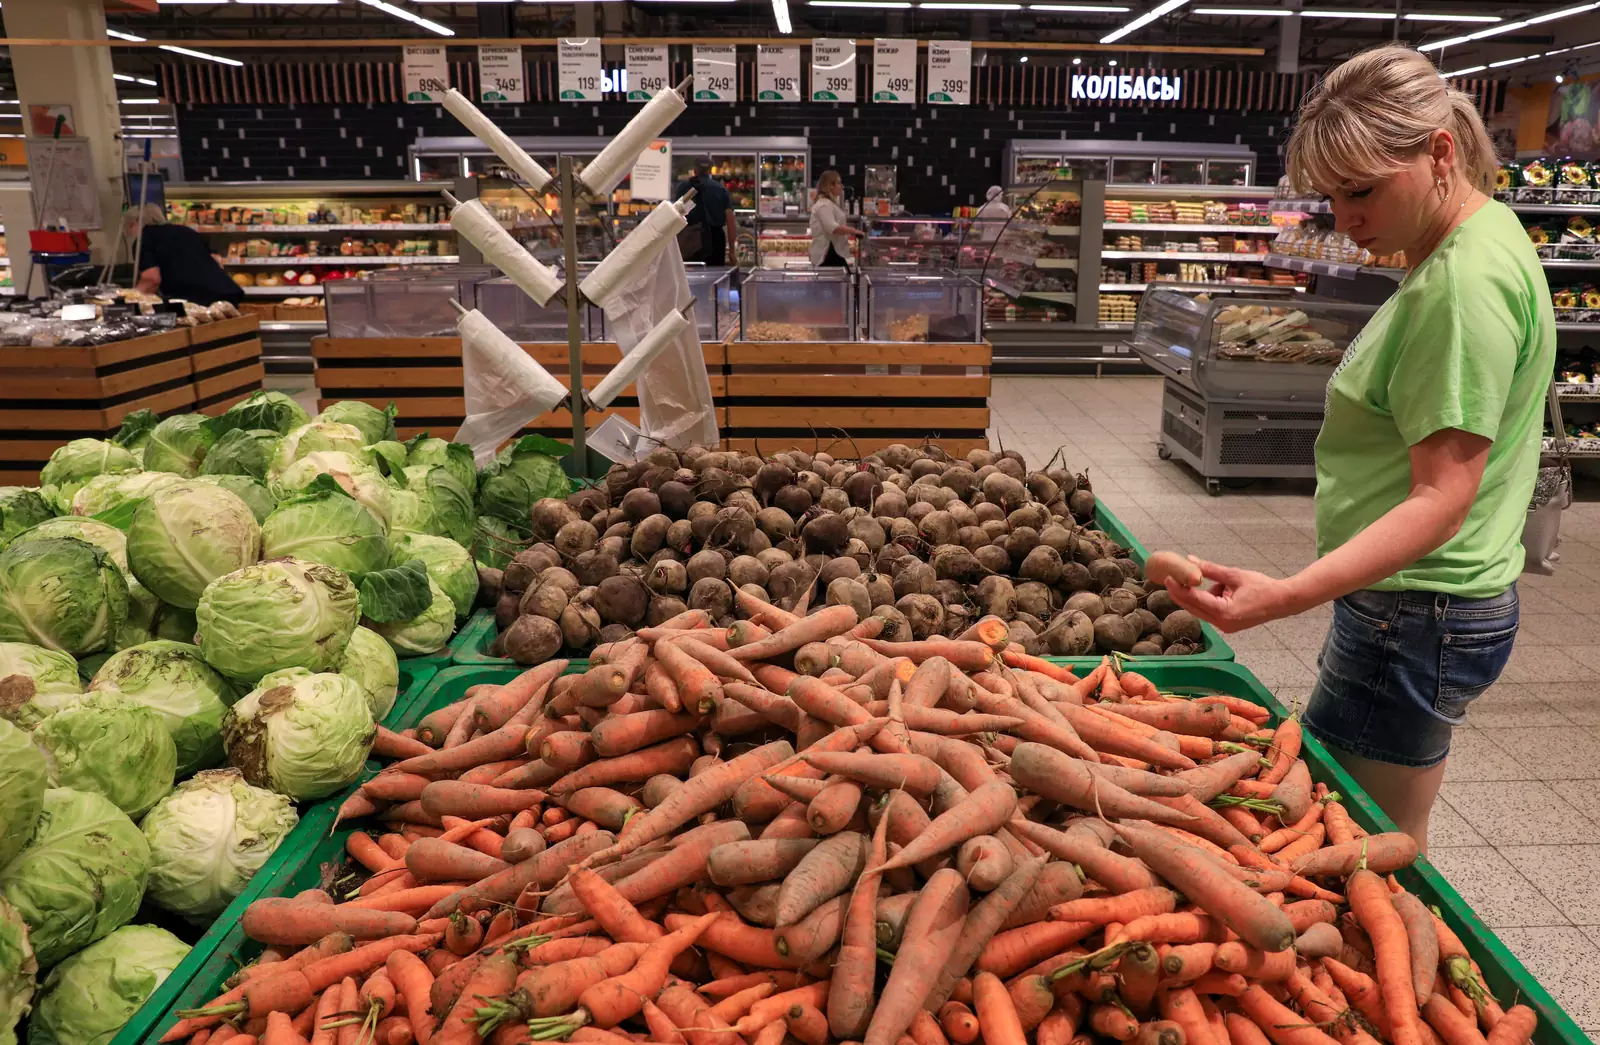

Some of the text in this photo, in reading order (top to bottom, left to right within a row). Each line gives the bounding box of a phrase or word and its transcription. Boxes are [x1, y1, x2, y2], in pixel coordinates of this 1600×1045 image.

[495, 78, 516, 92] 349
[578, 77, 595, 90] 119
[640, 77, 662, 91] 649
[708, 77, 729, 91] 249
[774, 77, 793, 91] 199
[826, 77, 848, 91] 399
[887, 78, 909, 92] 499
[941, 79, 963, 93] 399
[1071, 74, 1181, 101] КОЛБАСЫ
